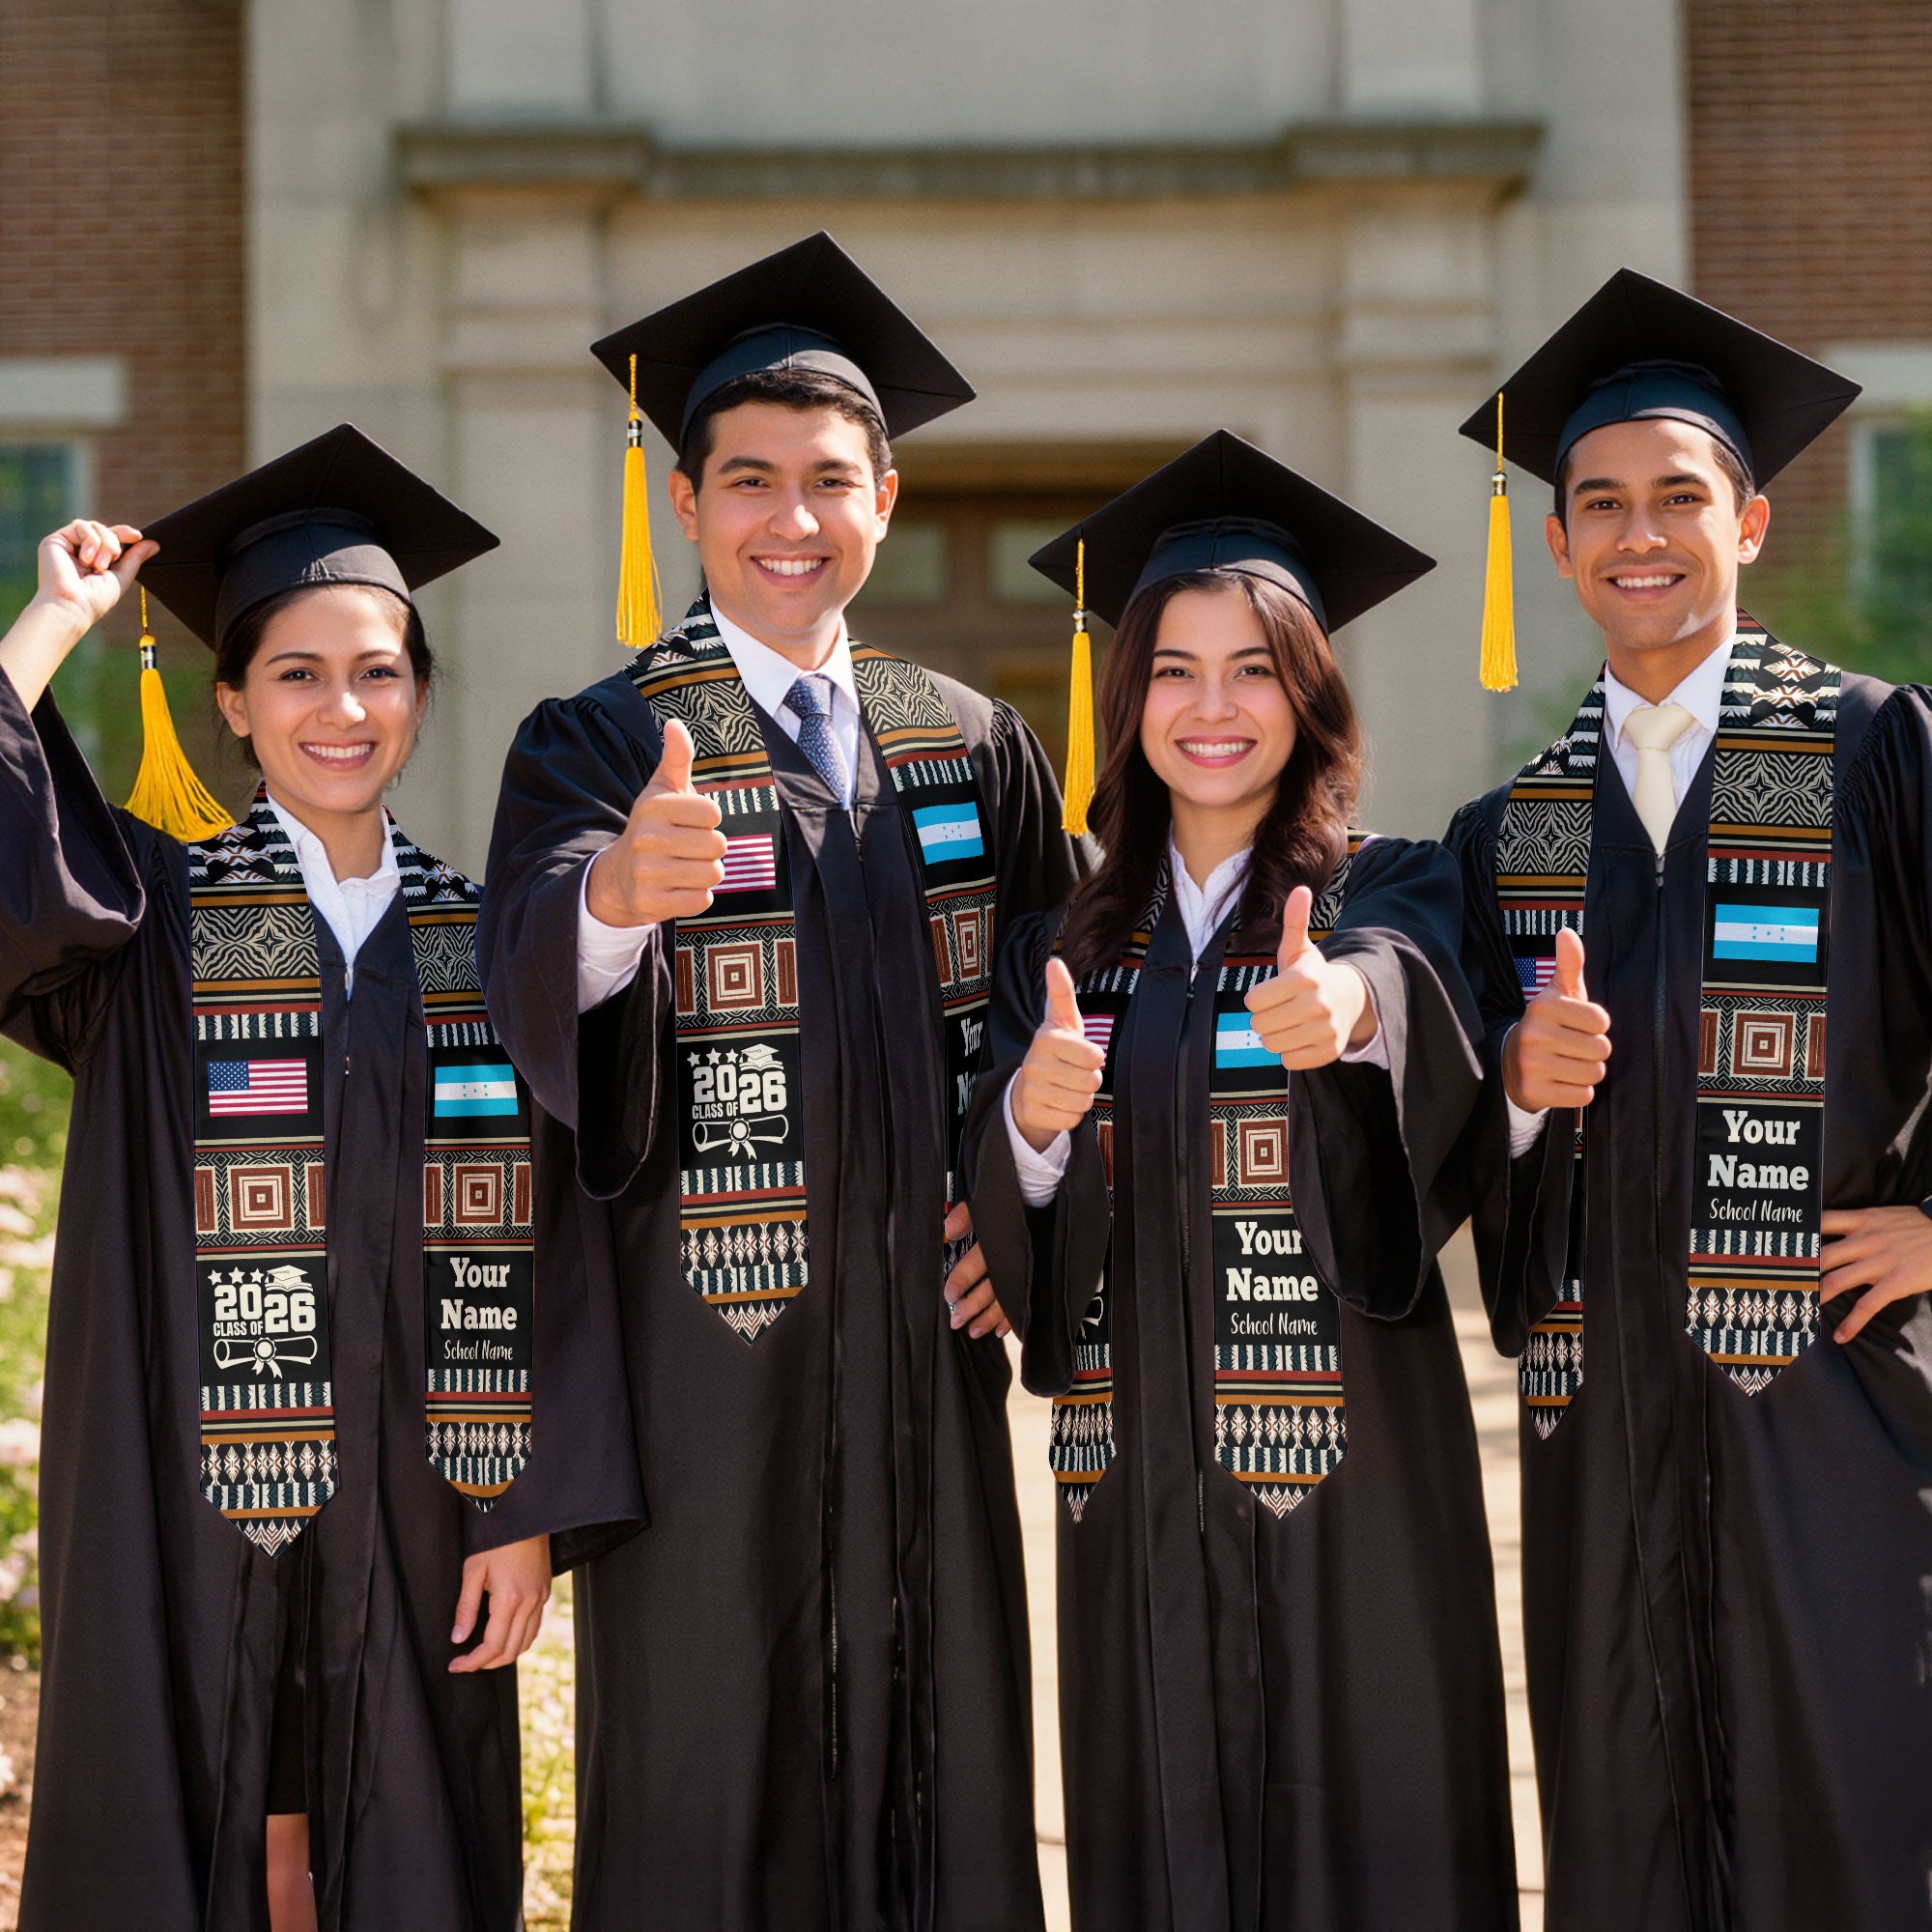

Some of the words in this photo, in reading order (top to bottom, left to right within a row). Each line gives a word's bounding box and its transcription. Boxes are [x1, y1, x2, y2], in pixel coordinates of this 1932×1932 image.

[960, 1017, 983, 1057] Your
[693, 1063, 787, 1115] 2026
[692, 1102, 724, 1120] CLASS
[726, 1101, 739, 1118] OF
[1721, 1109, 1801, 1146] Your
[1707, 1153, 1809, 1191] Name
[1709, 1198, 1756, 1221] School
[1760, 1200, 1804, 1223] Name
[1235, 1221, 1303, 1255] Your
[449, 1257, 511, 1288] Your
[1226, 1267, 1319, 1301] Name
[213, 1283, 317, 1333] 2026
[440, 1298, 518, 1331] Name
[1230, 1312, 1274, 1335] School
[1278, 1312, 1319, 1336] Name
[213, 1321, 247, 1337] CLASS
[249, 1320, 264, 1336] OF
[443, 1339, 479, 1360] School
[481, 1339, 514, 1361] Name
